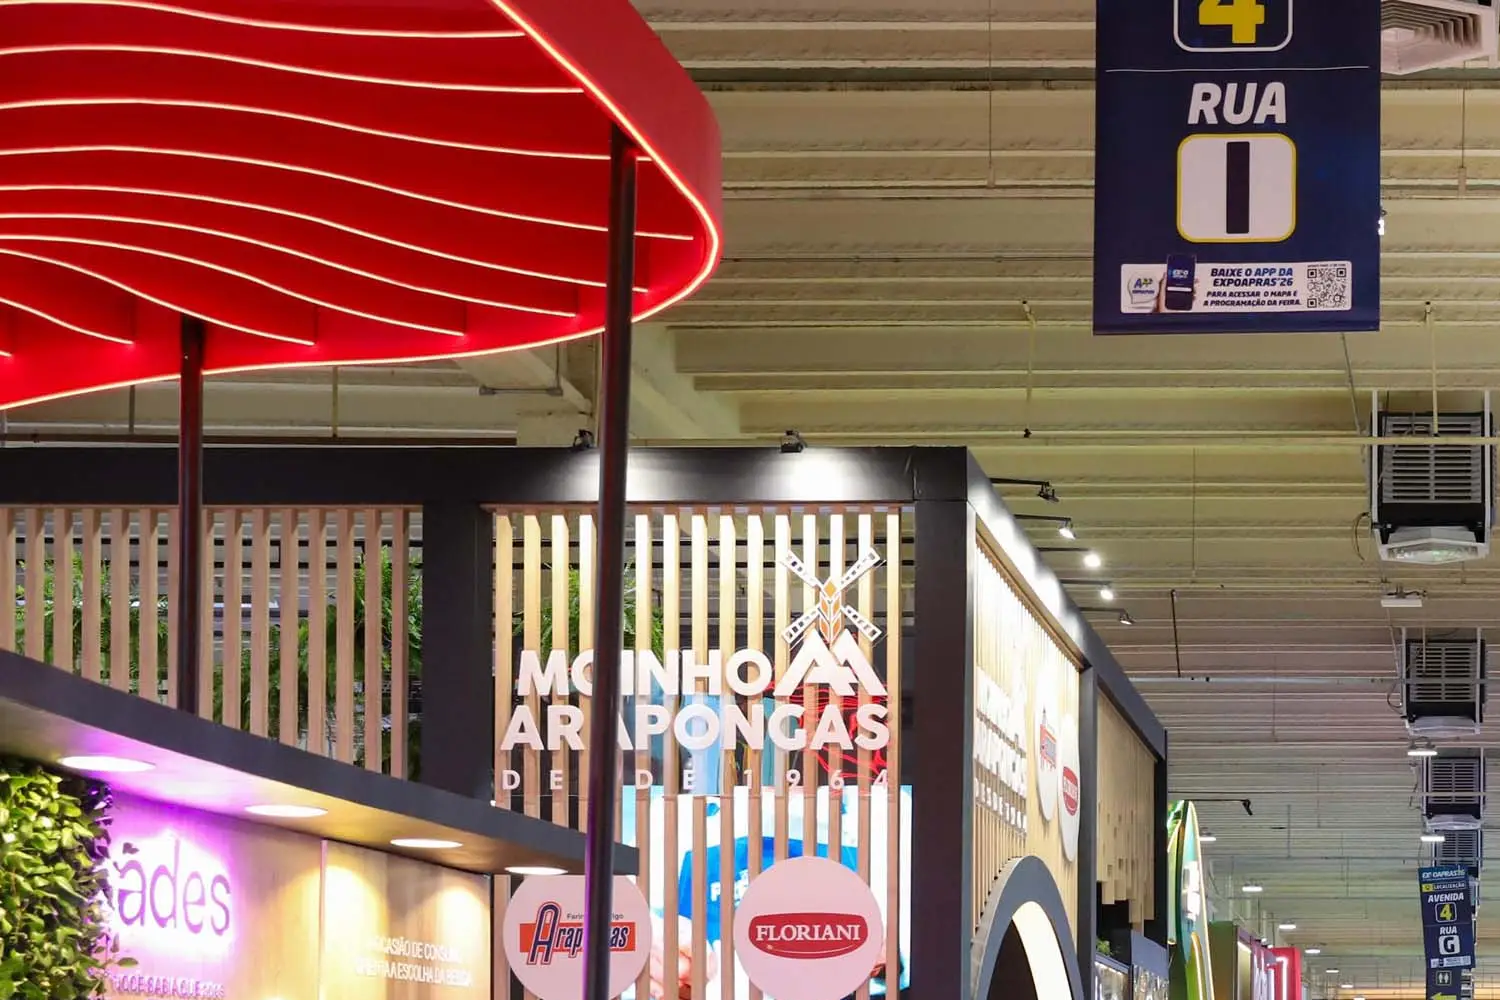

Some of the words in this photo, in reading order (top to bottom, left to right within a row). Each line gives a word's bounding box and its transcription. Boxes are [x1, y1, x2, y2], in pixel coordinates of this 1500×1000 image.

[1187, 82, 1286, 125] RUA
[1211, 268, 1241, 277] BAIXE
[1245, 268, 1251, 277] O
[1255, 268, 1275, 276] APP
[1279, 268, 1293, 276] DA
[1213, 278, 1293, 287] EXPOAPRAS'26
[1211, 299, 1265, 307] PROGRAMAÇÃO
[502, 768, 696, 791] DEDE
[116, 838, 231, 936] ades
[1428, 892, 1464, 903] AVENIDA
[1440, 904, 1452, 920] 4
[526, 901, 629, 965] Arapas
[755, 924, 861, 942] FLORIANI
[1440, 926, 1457, 935] RUA
[1443, 936, 1455, 953] G
